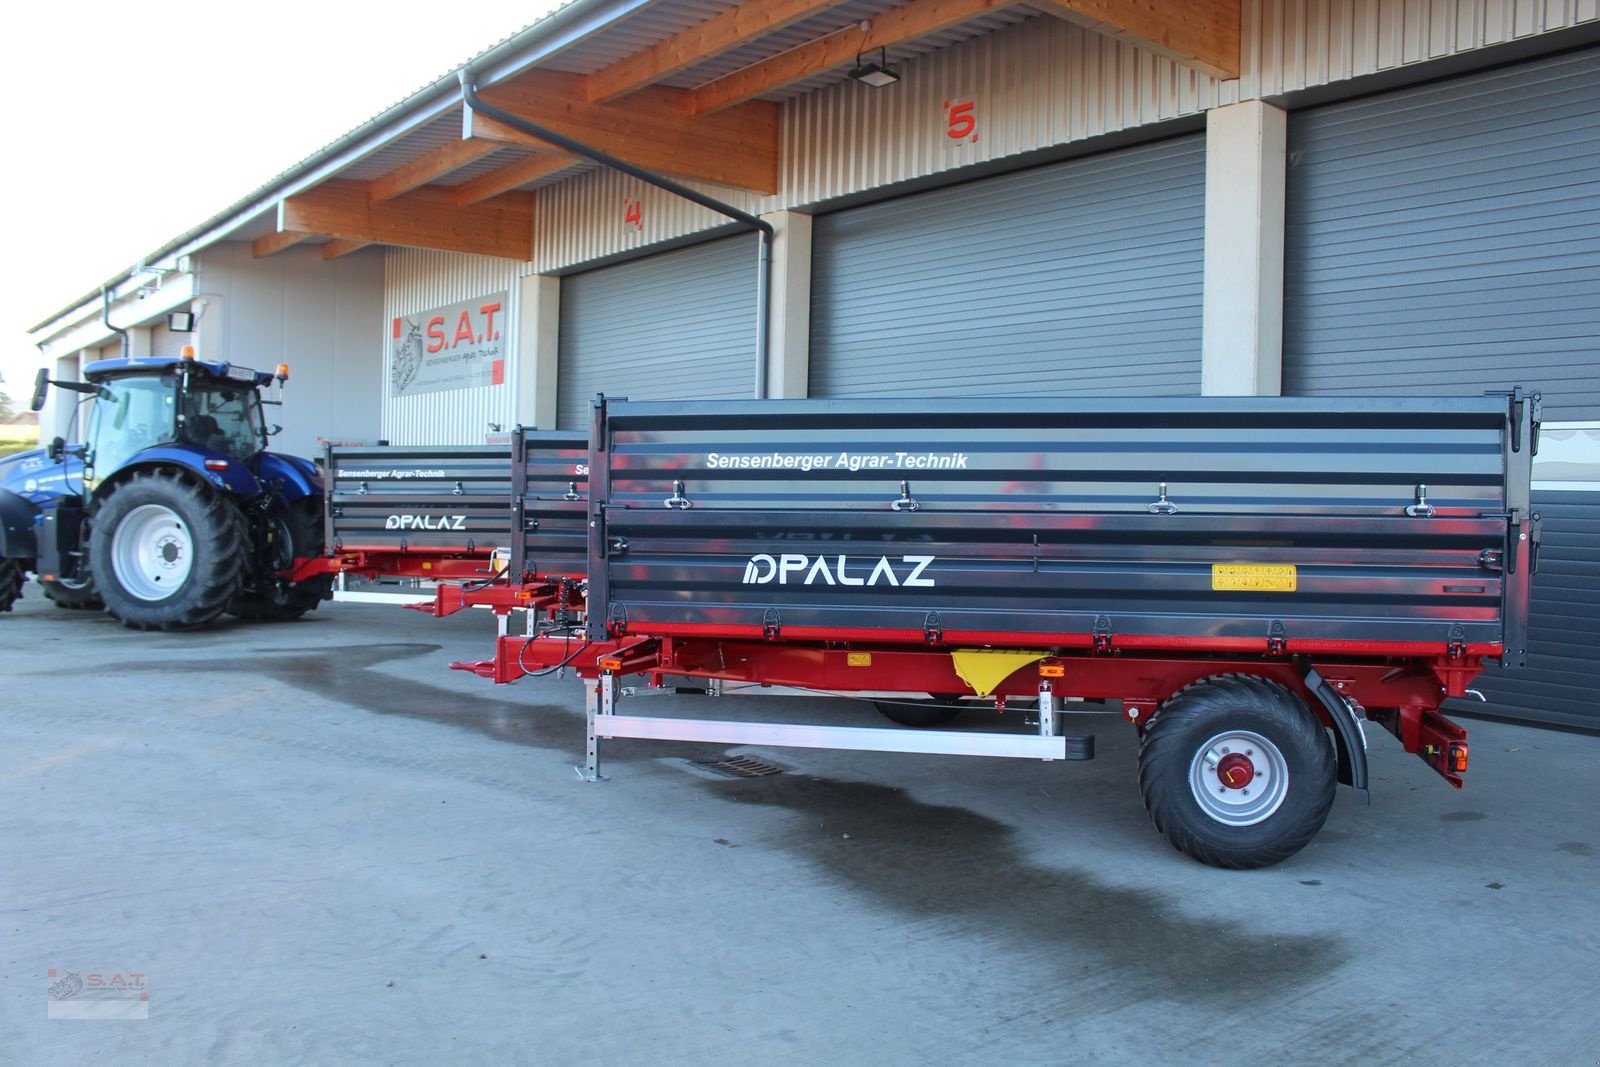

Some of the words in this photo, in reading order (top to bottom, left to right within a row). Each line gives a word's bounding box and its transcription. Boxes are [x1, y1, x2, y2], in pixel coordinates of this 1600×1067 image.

[426, 302, 501, 353] S.A.T.
[707, 452, 832, 472] Sensenberger
[835, 452, 969, 472] Agrar-Technik
[338, 469, 391, 479] Sensenberger
[391, 469, 445, 479] Agrar-Technik
